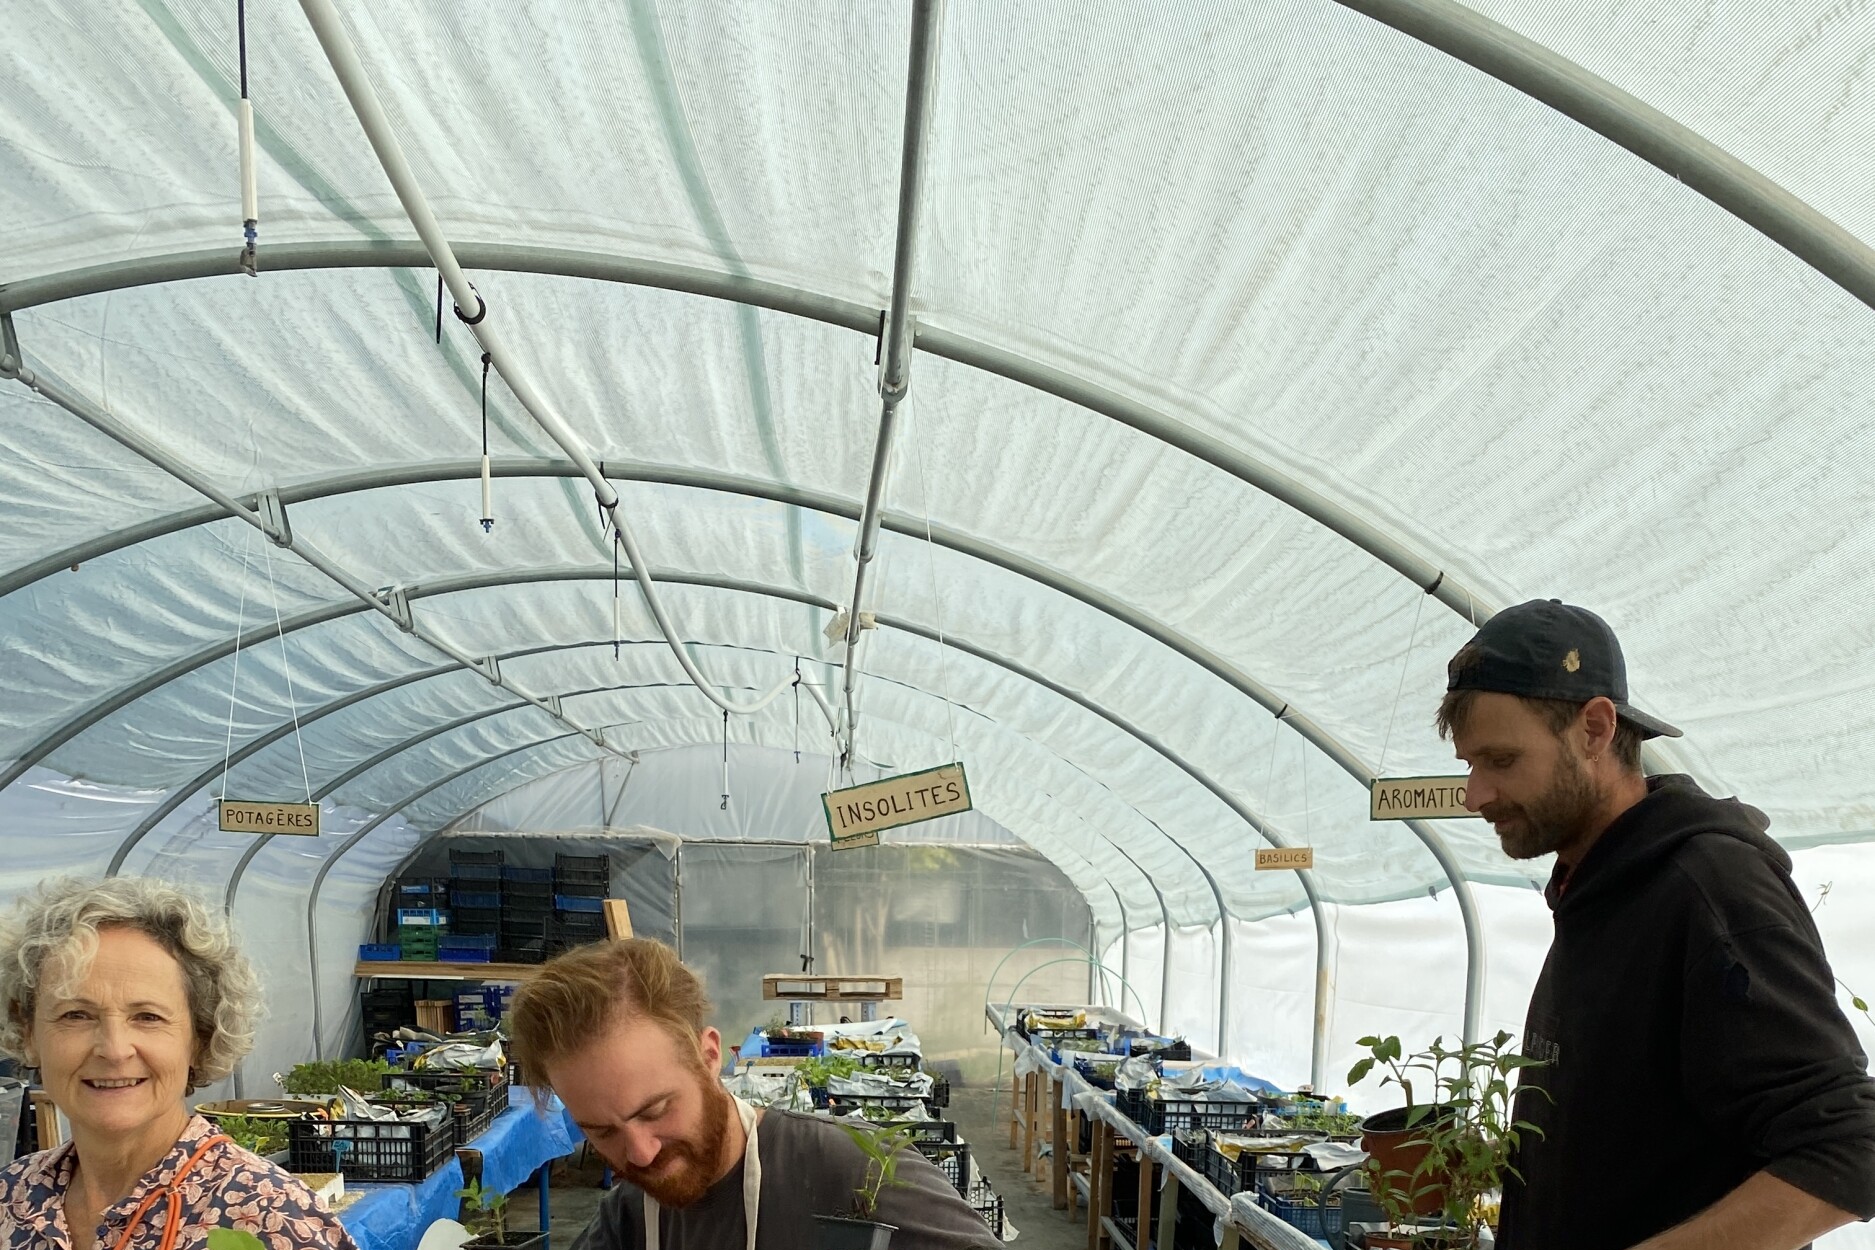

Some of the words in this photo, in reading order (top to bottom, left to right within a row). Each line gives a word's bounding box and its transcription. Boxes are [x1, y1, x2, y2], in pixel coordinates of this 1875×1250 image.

[836, 781, 961, 828] INSOLITES
[226, 808, 313, 827] POTAGÈRES
[1259, 853, 1308, 864] BASILICS
